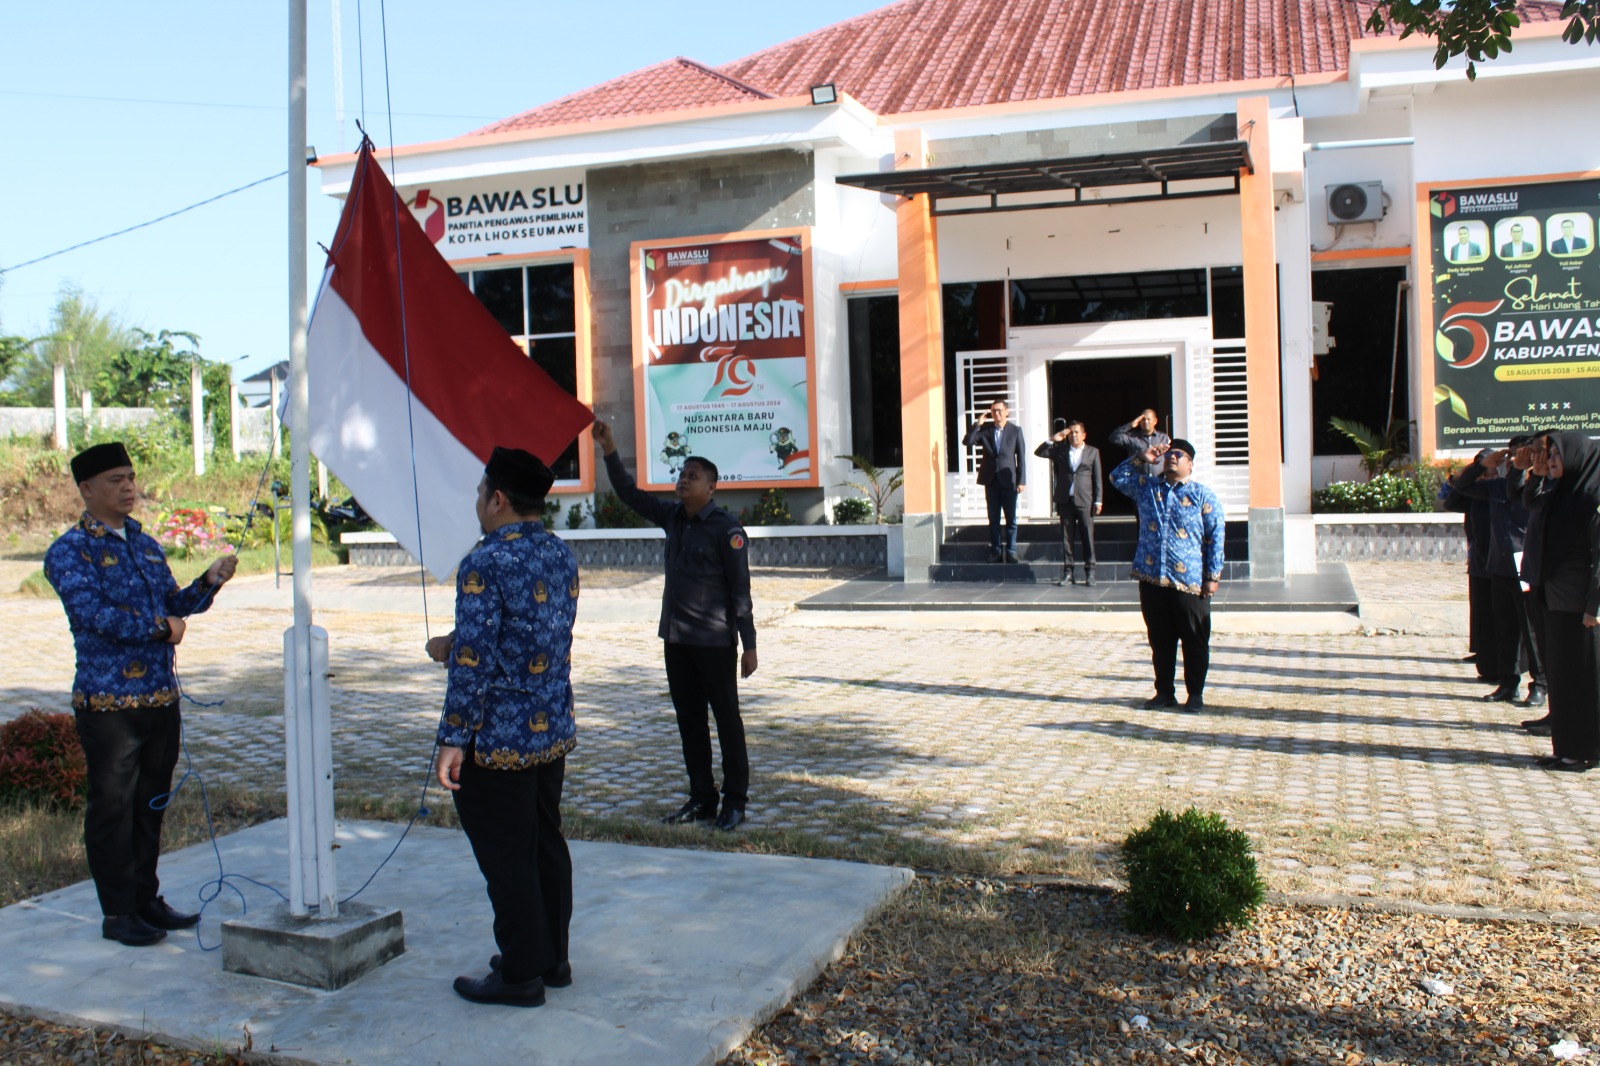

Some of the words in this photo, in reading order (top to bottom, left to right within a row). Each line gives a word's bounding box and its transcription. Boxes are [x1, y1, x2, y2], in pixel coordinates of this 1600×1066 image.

[447, 184, 583, 217] BAWASLU
[1460, 192, 1518, 206] BAWASLU
[448, 221, 482, 231] PANITIA
[484, 214, 534, 228] PENGAWAS
[536, 211, 584, 223] PEMILIHAN
[449, 233, 481, 244] KOTA
[485, 224, 584, 241] LHOKSEUMAWE
[667, 249, 708, 260] BAWASLU
[664, 266, 788, 311] Dirgahayu
[1504, 274, 1582, 310] Selamat
[1530, 302, 1550, 311] Hari
[1553, 300, 1581, 310] Ulang
[654, 300, 801, 346] INDONESIA
[684, 413, 744, 424] NUSANTARA
[748, 412, 774, 420] BARU
[1476, 416, 1519, 425] Bersama
[1522, 415, 1556, 426] Rakyat
[1558, 413, 1588, 422] Awasi
[687, 424, 741, 434] INDONESIA
[744, 423, 772, 432] MAJU
[1444, 426, 1486, 434] Bersama
[1489, 424, 1528, 432] Bawaslu
